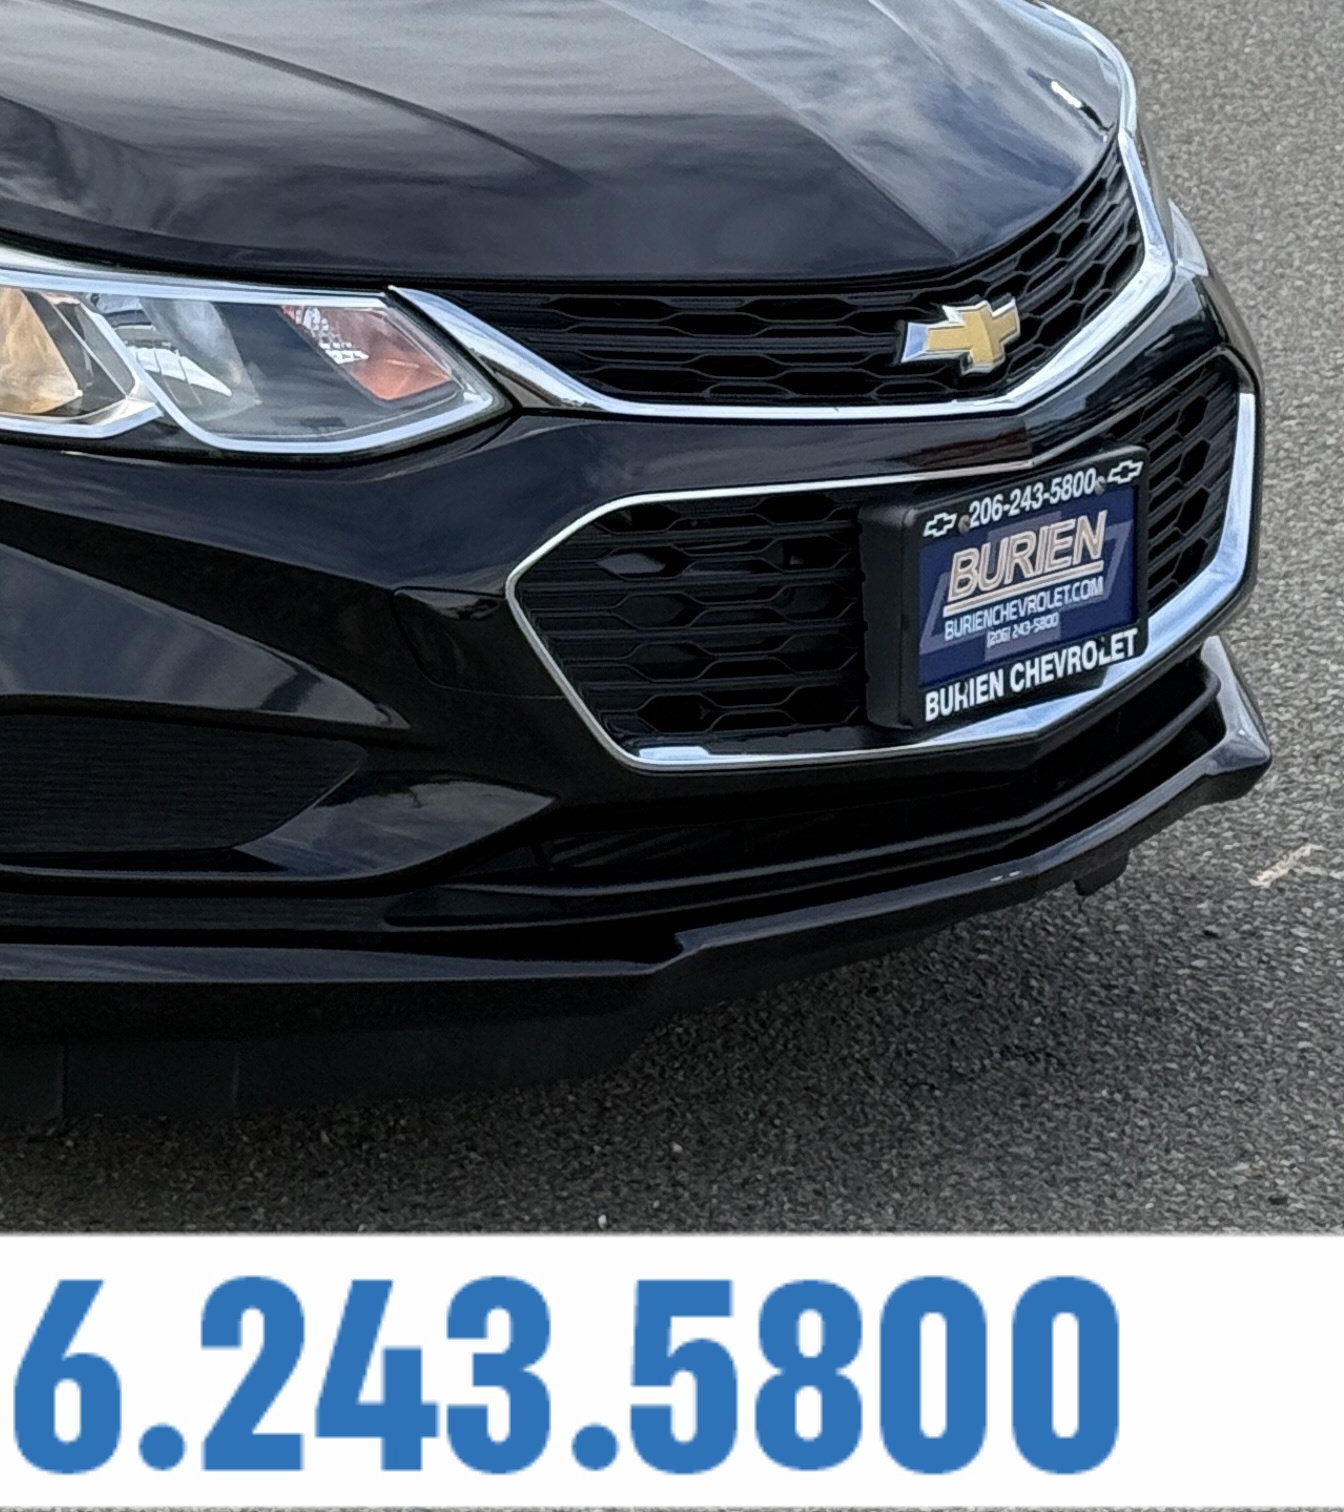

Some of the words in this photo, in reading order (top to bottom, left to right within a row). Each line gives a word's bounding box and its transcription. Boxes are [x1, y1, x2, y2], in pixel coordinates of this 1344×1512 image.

[969, 467, 1097, 528] 206-243-5800
[946, 510, 1109, 602] BURIEN
[944, 575, 1105, 642] BURIENCHEVROLET.COM
